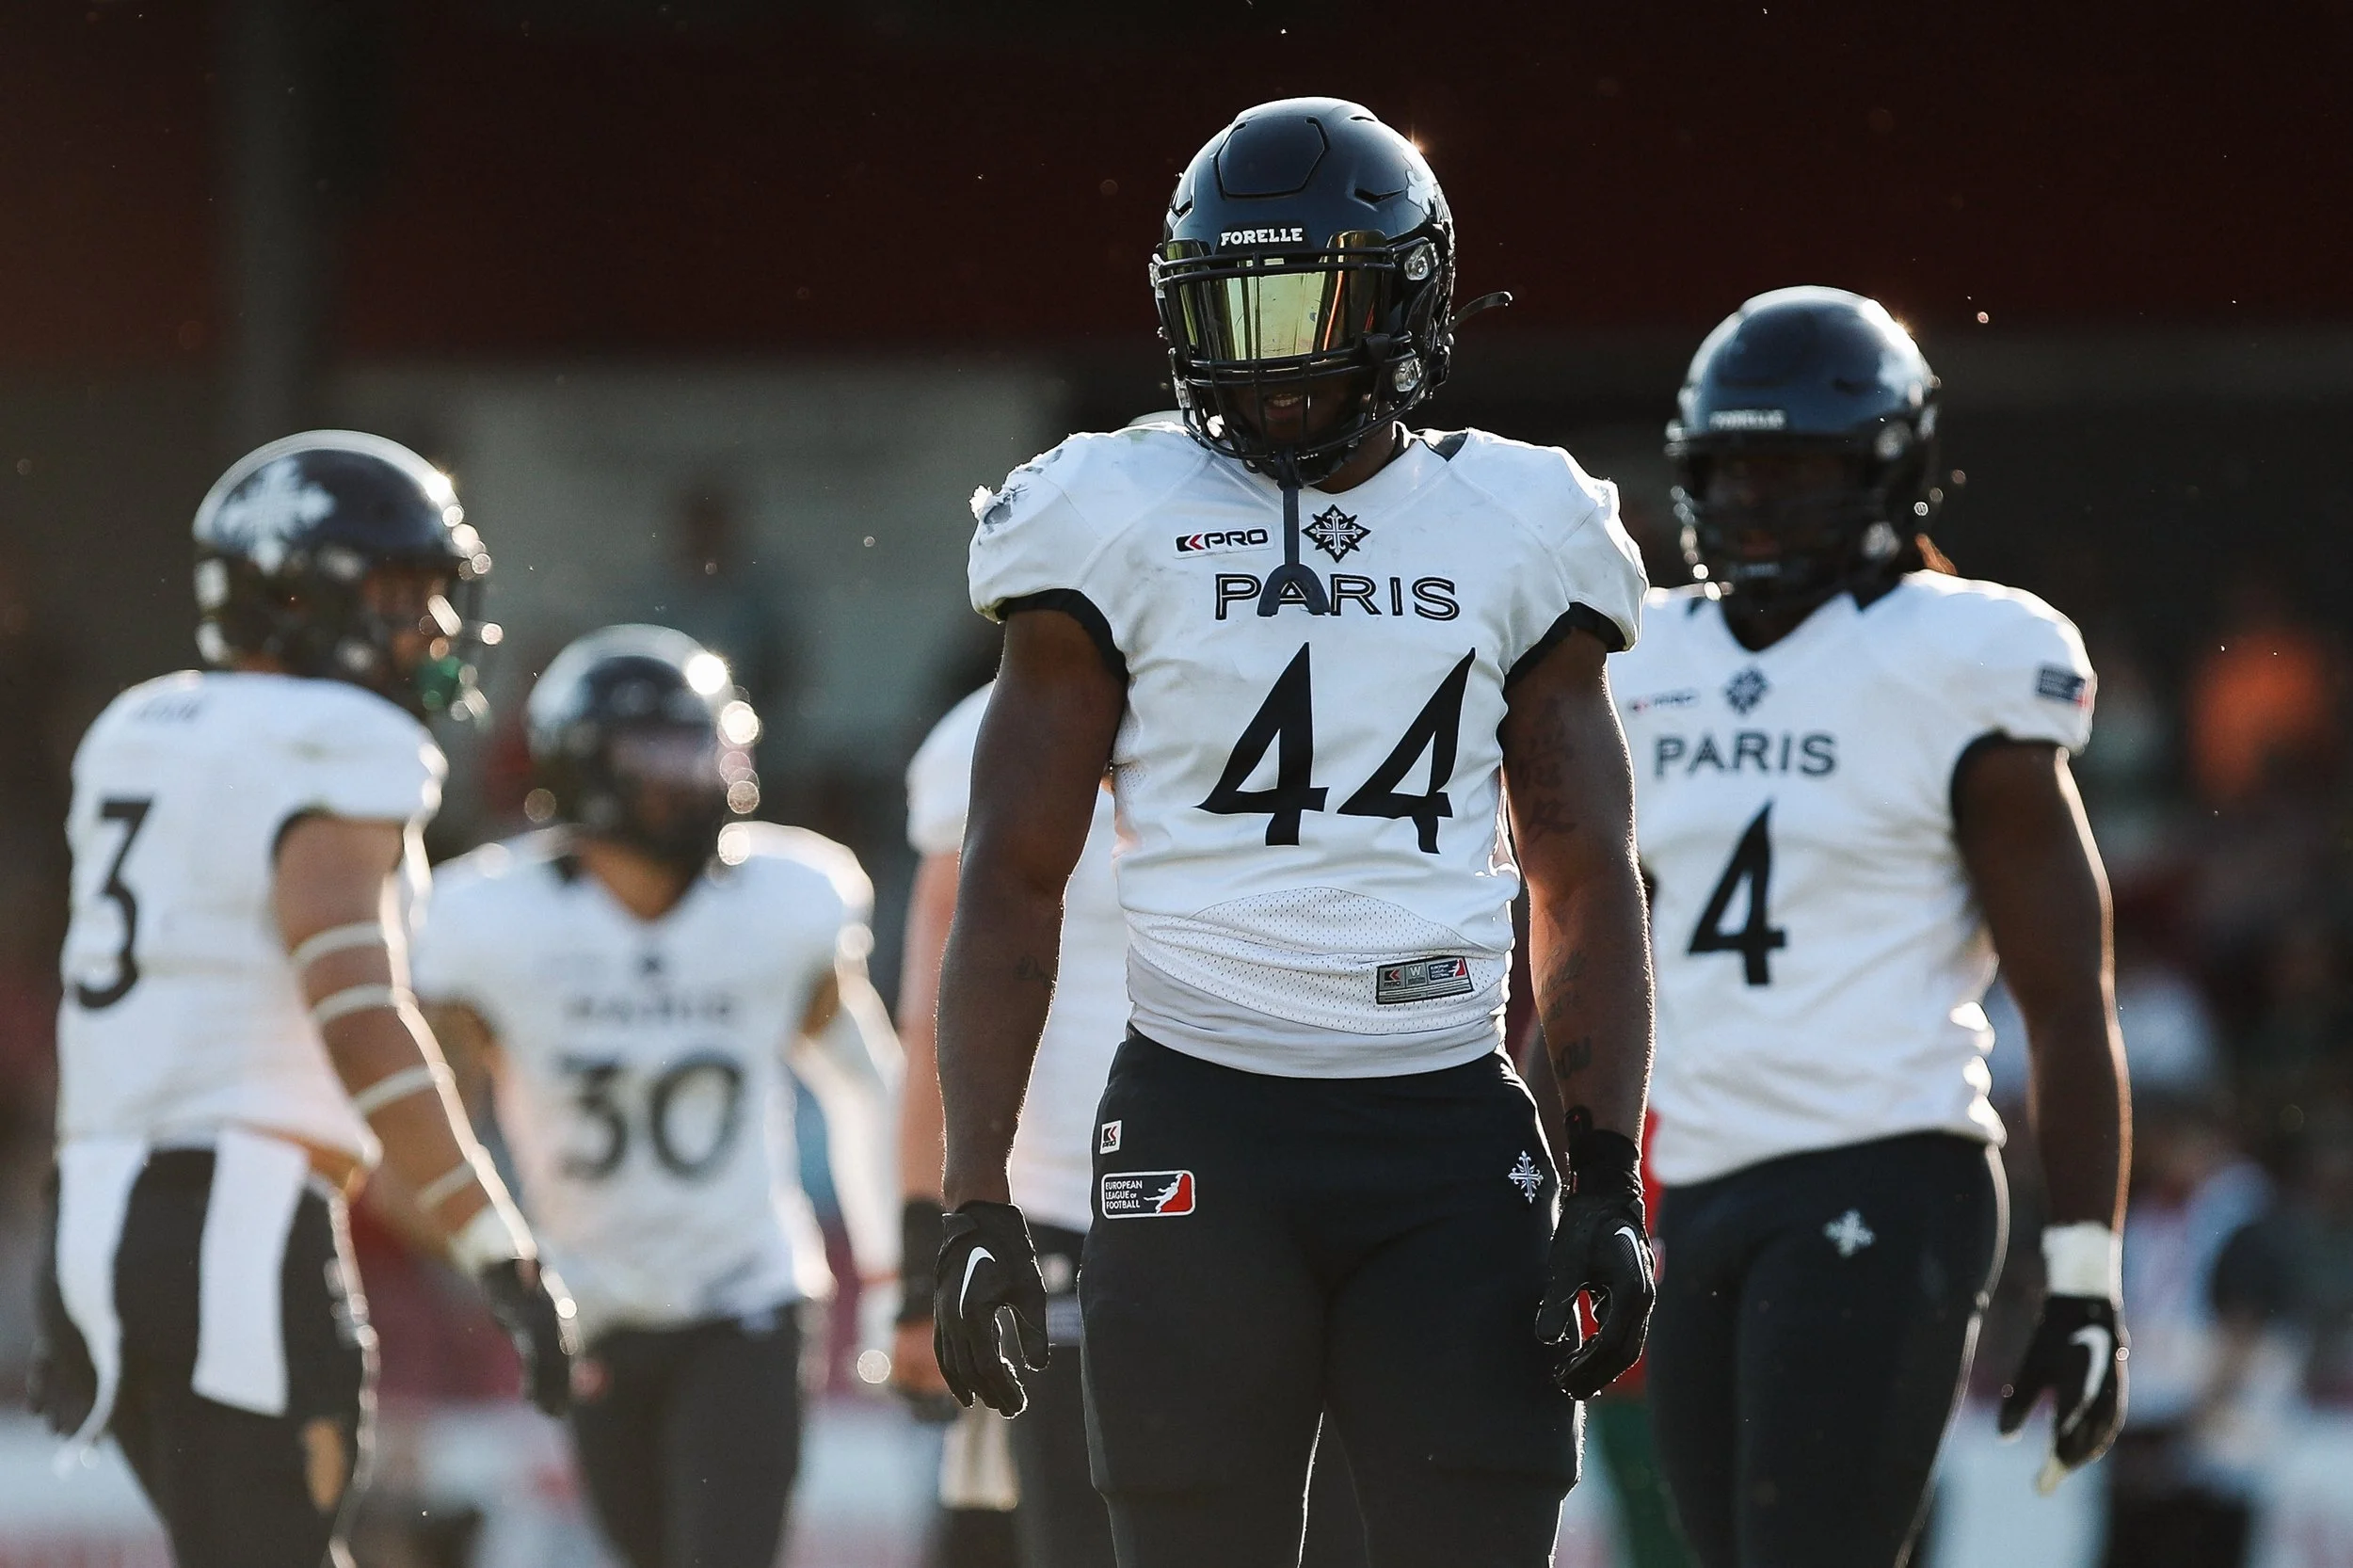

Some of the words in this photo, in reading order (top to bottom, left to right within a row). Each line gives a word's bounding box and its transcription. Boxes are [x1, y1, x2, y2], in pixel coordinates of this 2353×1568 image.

[1221, 228, 1303, 246] FORELLE
[1193, 642, 1476, 855] 44
[1654, 731, 1836, 777] PARIS
[77, 797, 153, 1010] 3
[1688, 796, 1786, 986] 4
[555, 1049, 745, 1180] 30
[1105, 1180, 1143, 1190] EUROPEAN
[1105, 1191, 1129, 1199] LEAGUE
[1106, 1200, 1140, 1209] FOOTBALL
